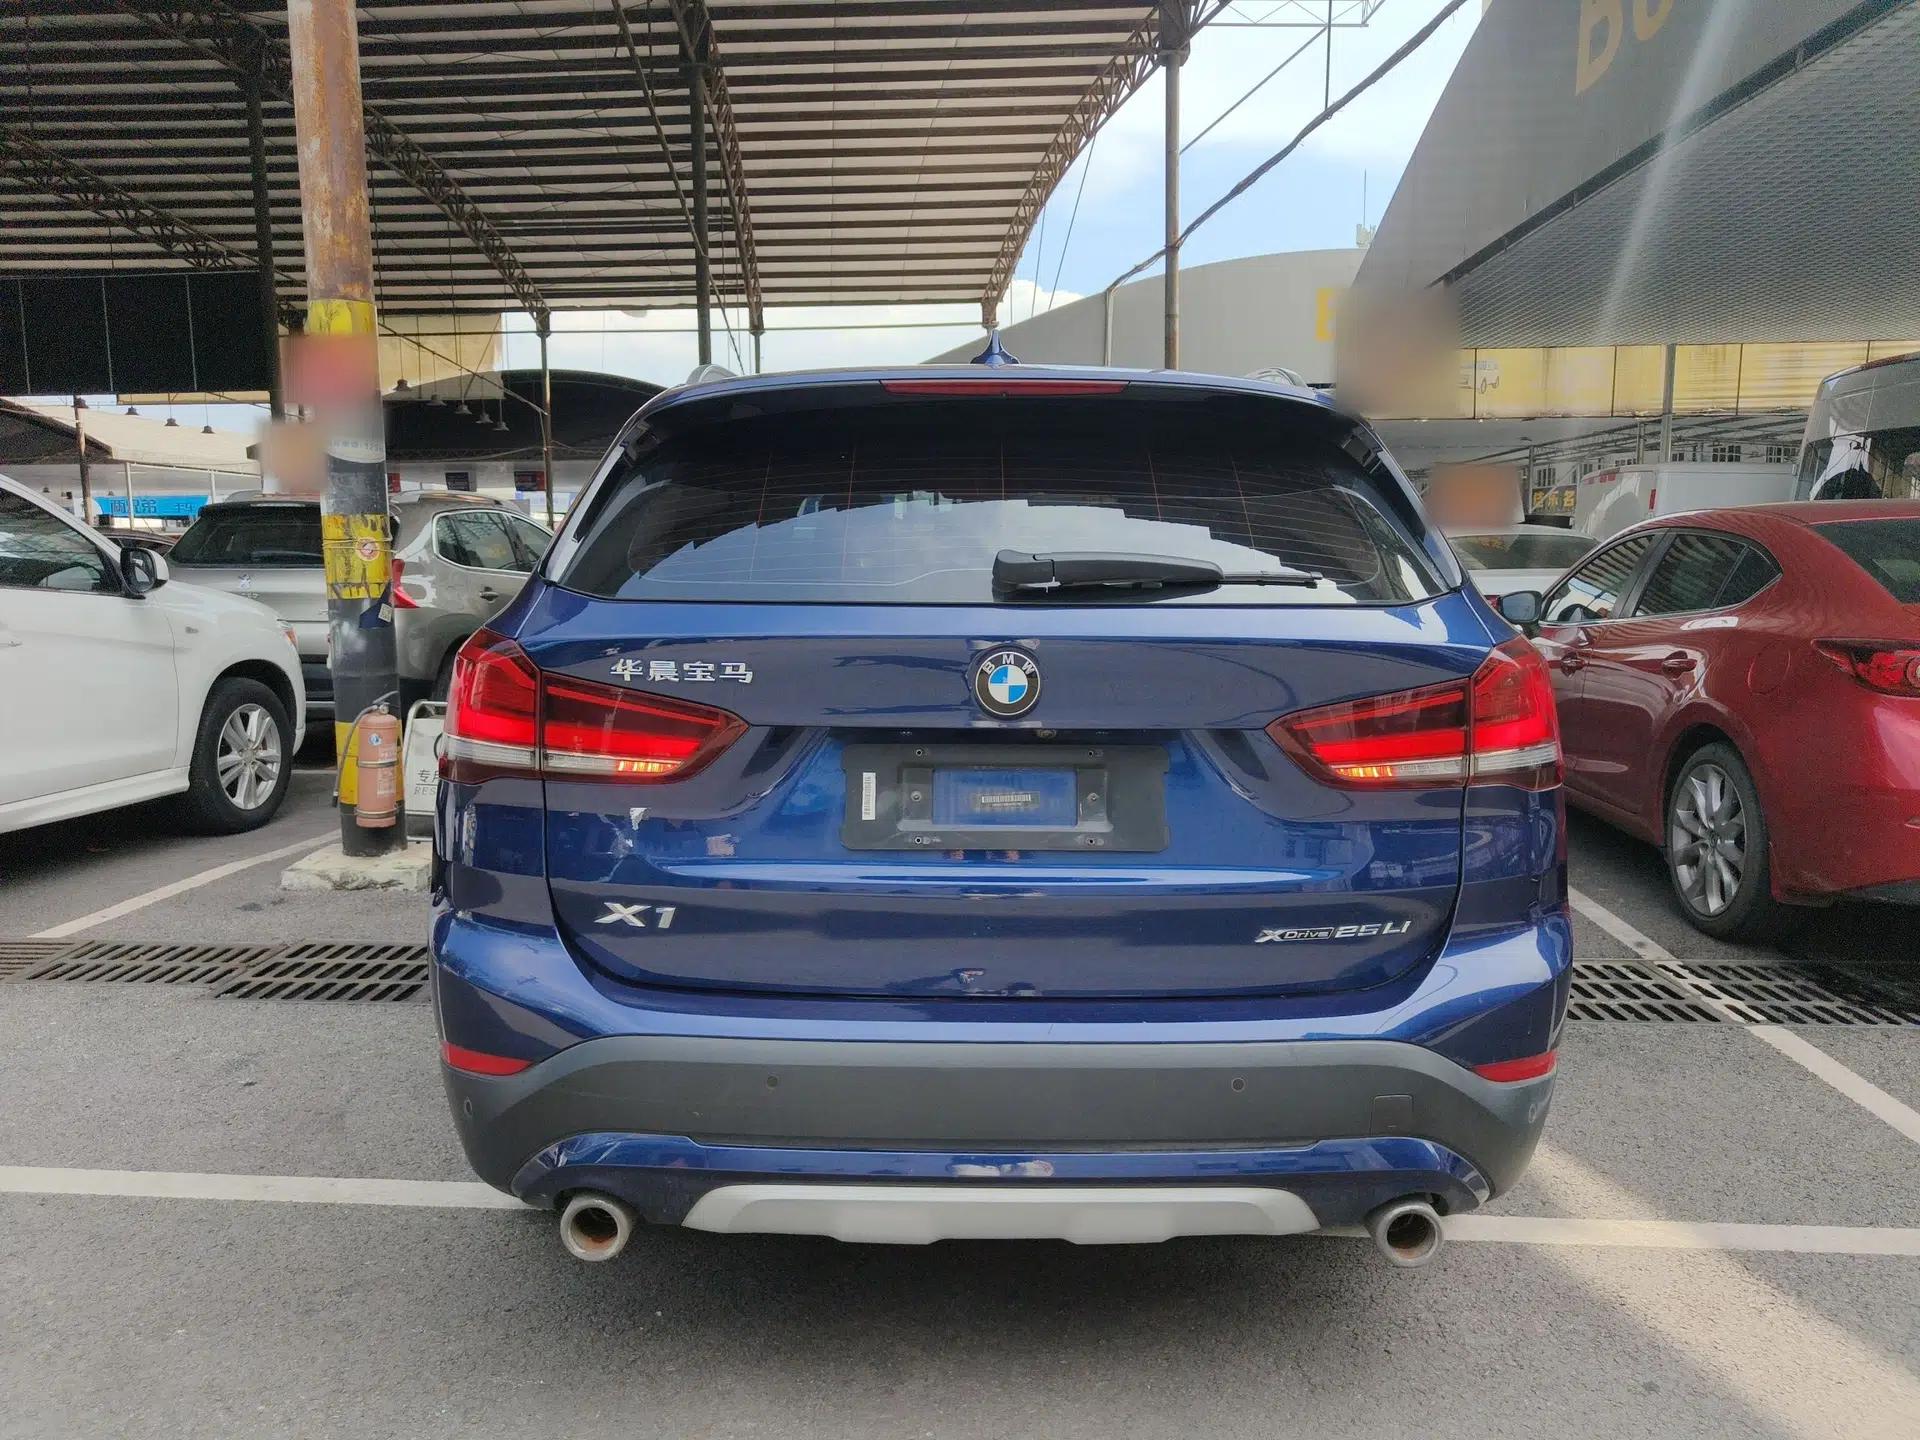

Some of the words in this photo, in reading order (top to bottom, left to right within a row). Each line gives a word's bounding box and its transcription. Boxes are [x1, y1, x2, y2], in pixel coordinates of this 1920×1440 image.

[610, 658, 753, 684] 华晨宝马
[982, 653, 1035, 675] BMW
[593, 902, 676, 929] X1
